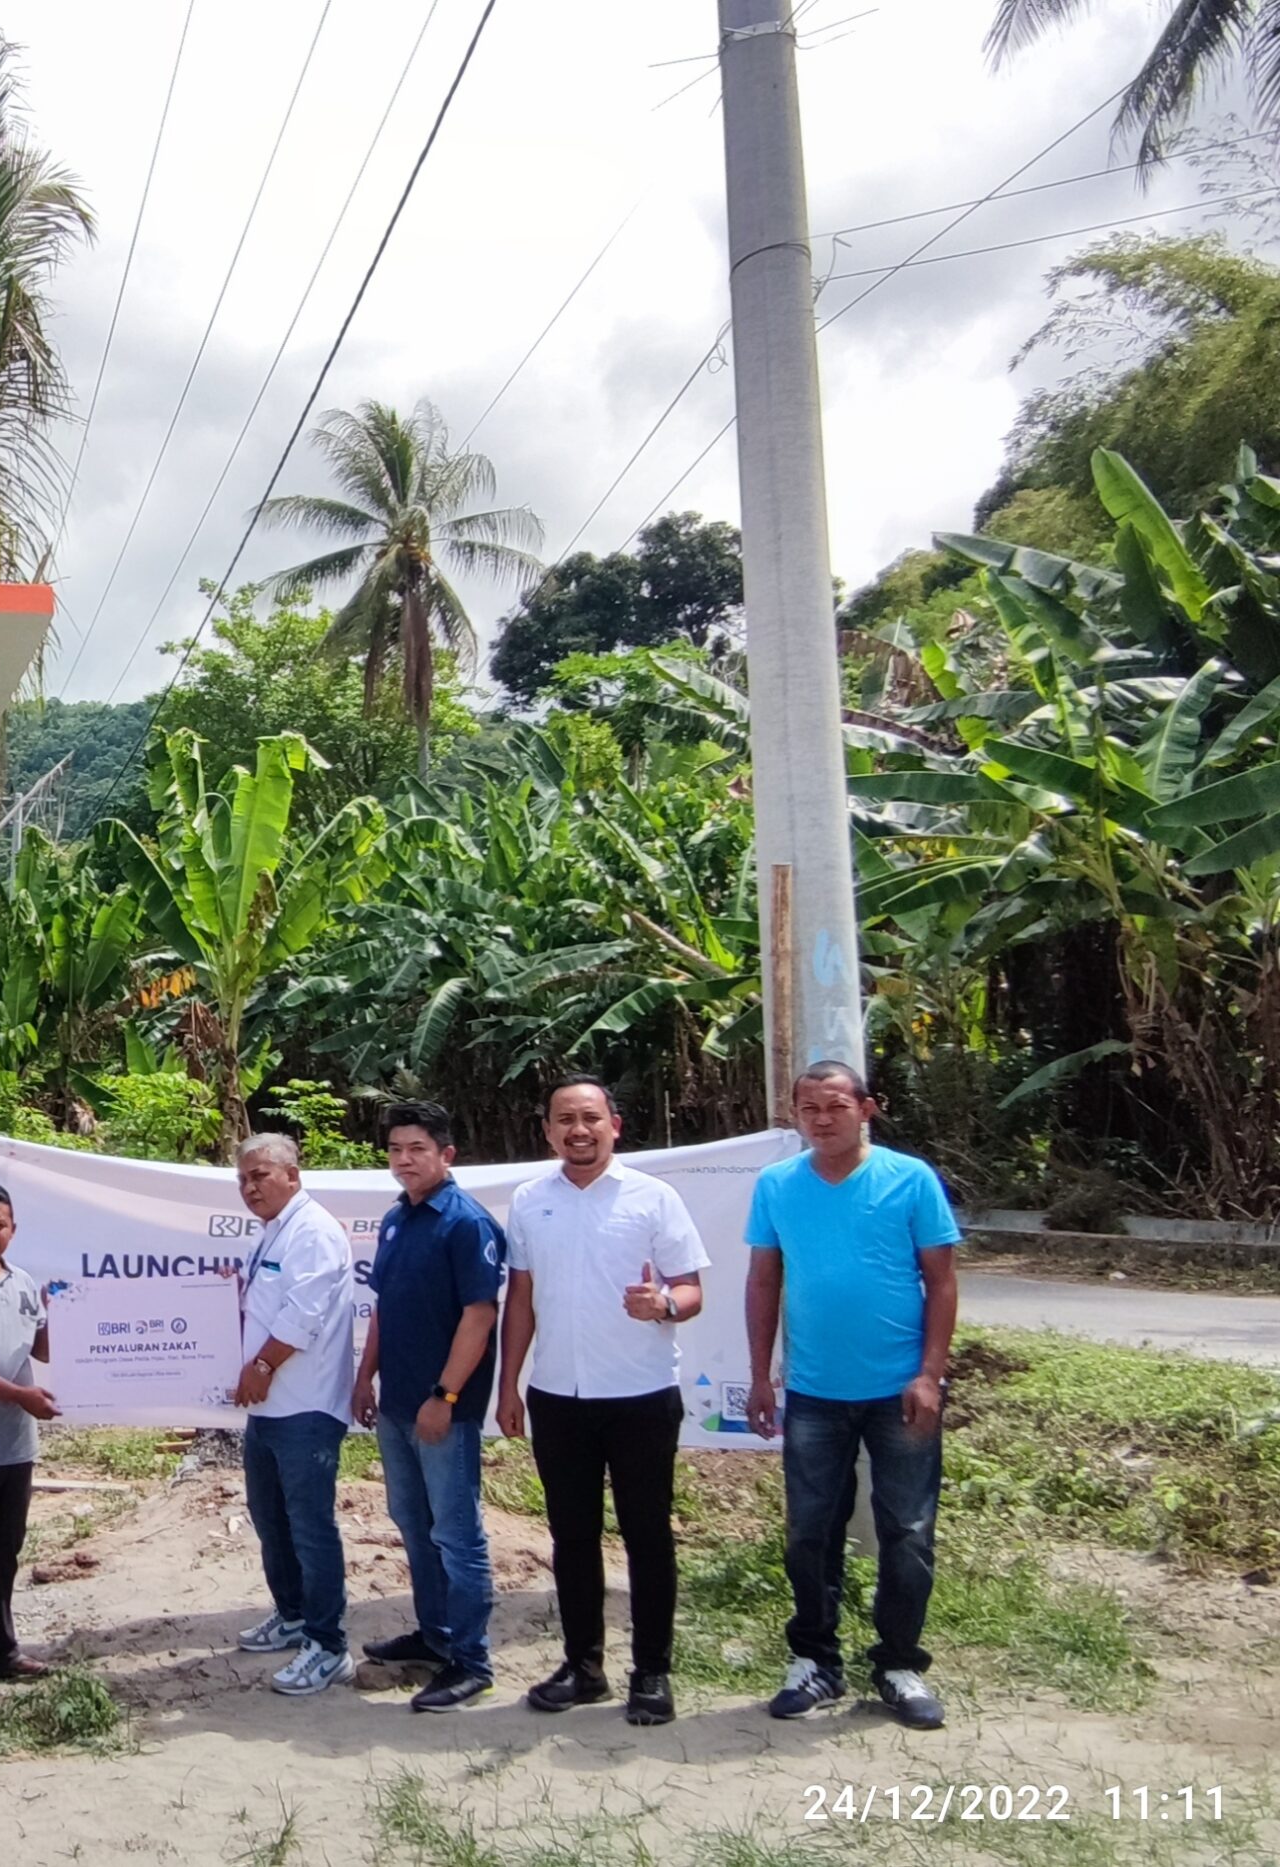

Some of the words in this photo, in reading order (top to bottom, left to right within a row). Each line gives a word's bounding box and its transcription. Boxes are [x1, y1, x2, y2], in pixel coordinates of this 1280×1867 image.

[111, 1322, 131, 1335] BRI
[89, 1342, 160, 1355] PENYALURAN
[162, 1341, 198, 1352] ZAKAT
